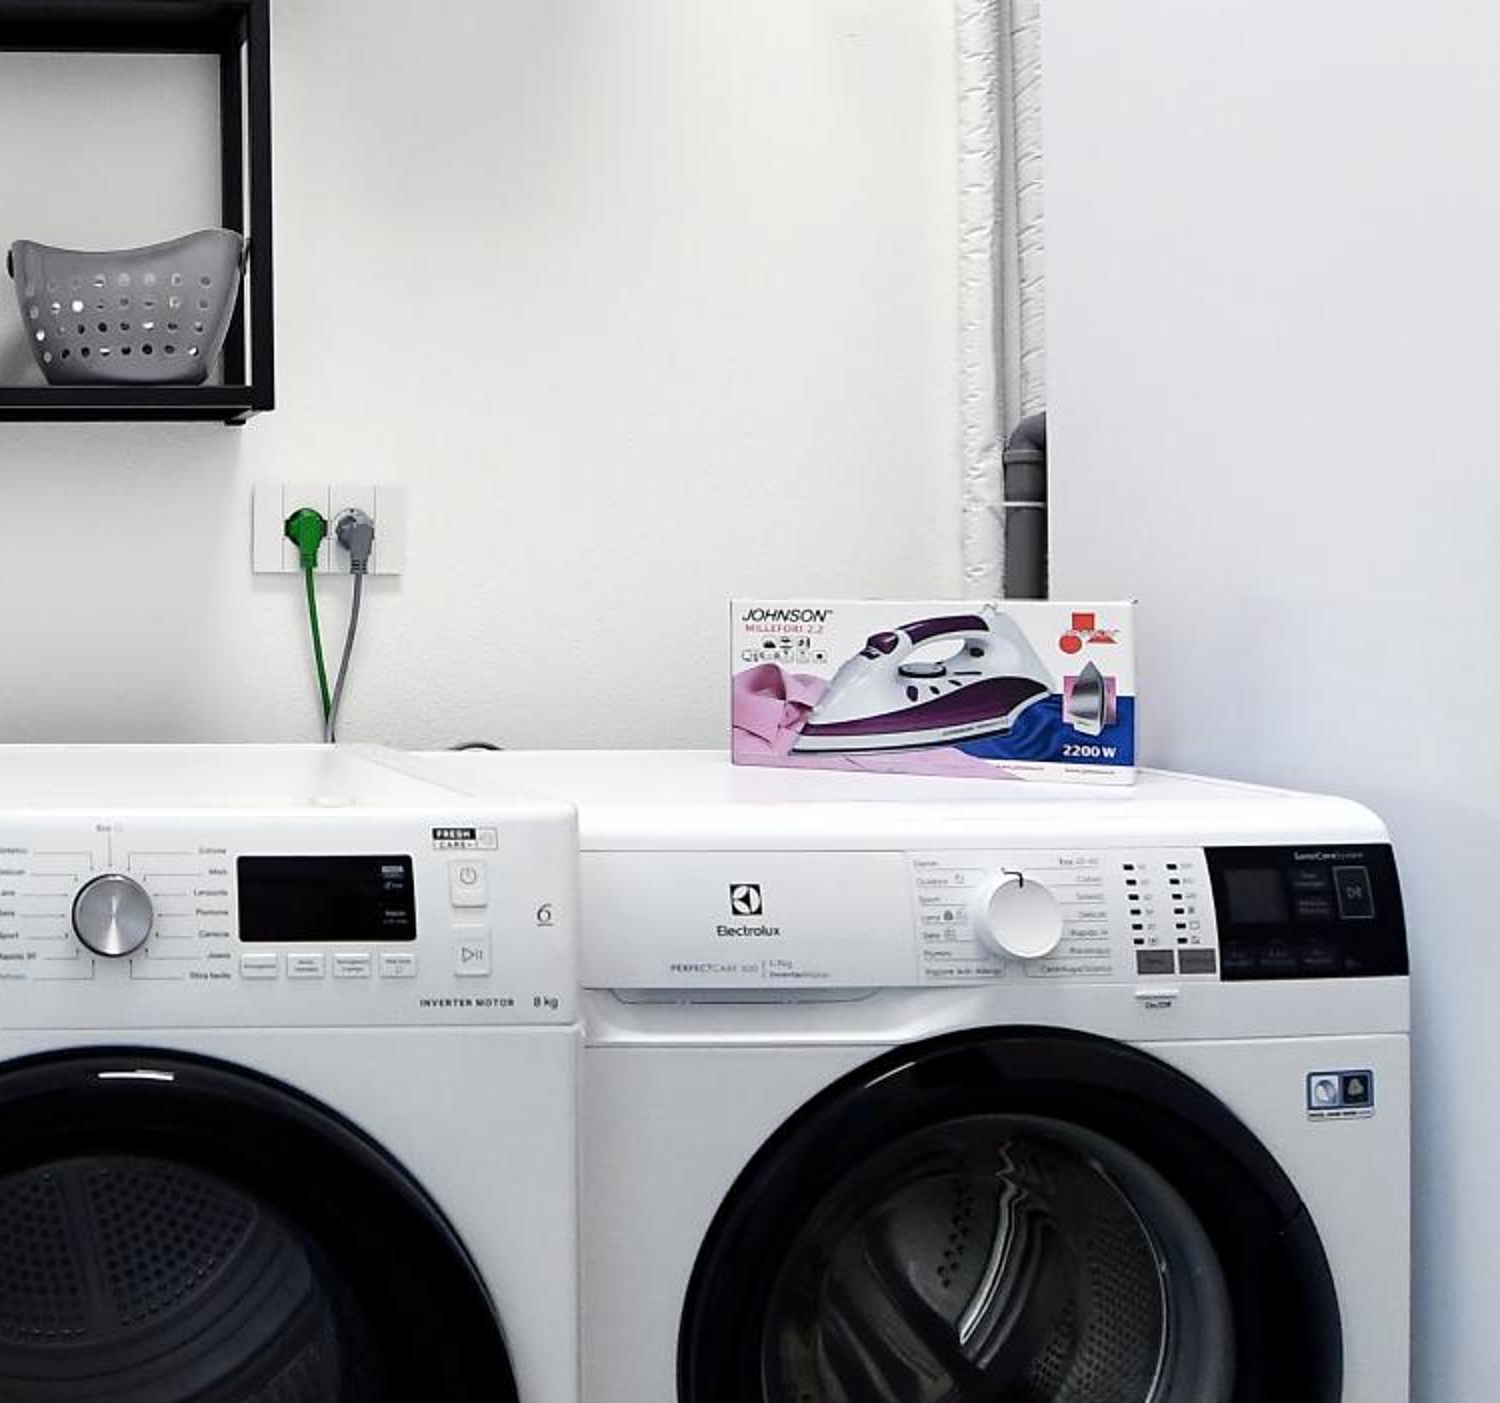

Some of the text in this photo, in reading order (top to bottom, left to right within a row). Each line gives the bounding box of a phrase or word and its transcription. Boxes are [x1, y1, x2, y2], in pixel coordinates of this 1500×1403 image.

[1062, 745, 1117, 758] 2200 W
[436, 829, 472, 839] FRESH
[717, 924, 781, 937] Electrolux
[420, 998, 515, 1007] INVERTER MOTOR
[543, 996, 559, 1010] kg
